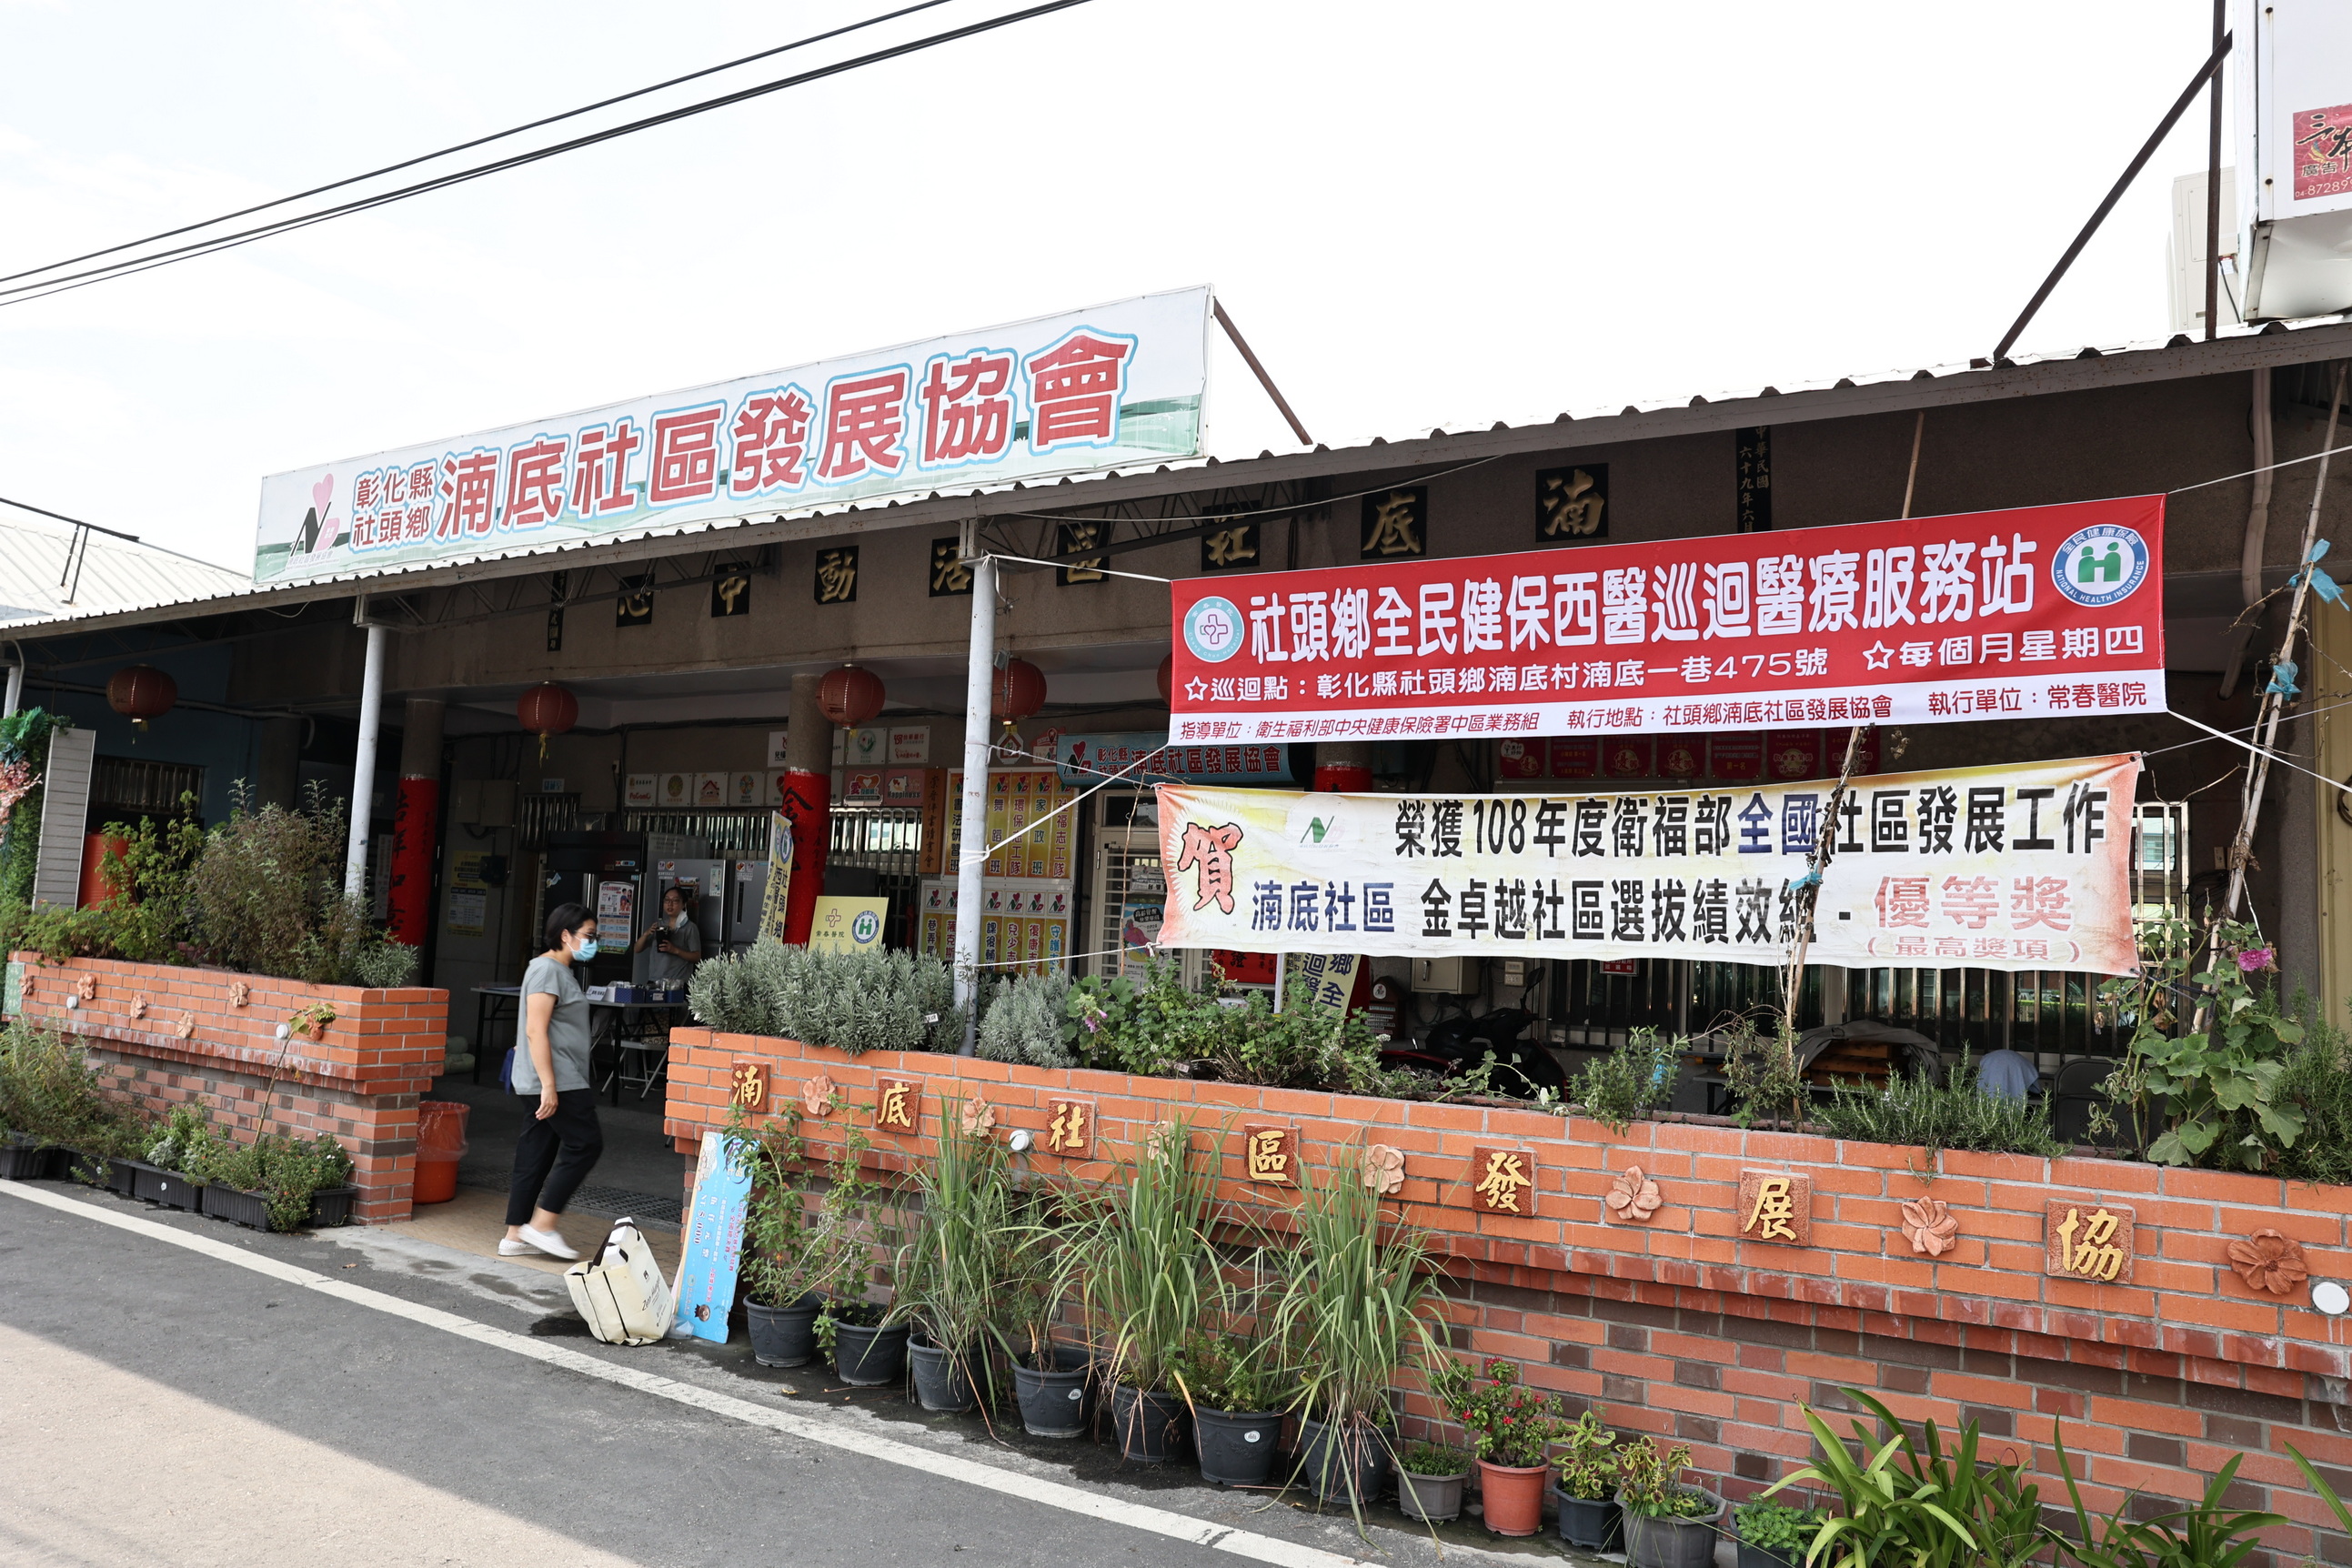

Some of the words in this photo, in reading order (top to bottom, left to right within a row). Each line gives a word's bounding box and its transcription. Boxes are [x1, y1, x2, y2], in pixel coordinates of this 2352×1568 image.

[2302, 162, 2337, 176] 廣告
[437, 335, 1129, 539] 湳底社區發展協會
[357, 465, 434, 509] 彰化縣
[353, 505, 431, 548] 社頭鄉
[2062, 527, 2140, 555] 全民健康保險
[1250, 532, 2037, 664] 社頭鄉全民健保西醫巡迴醫療服務站
[2055, 569, 2077, 598] NATIONAL
[2079, 594, 2113, 603] HEALTH
[2114, 560, 2145, 598] INSURANCE
[1898, 626, 2145, 667] 每個月星期四
[1180, 711, 1541, 740] 指導單位：衛生福利部中央健康保險署中區業務組
[1568, 695, 1893, 729] 執行地點：社頭鄉湳底社區發展協會
[1928, 681, 2147, 717] 執行單位：常春醫院
[887, 790, 920, 799] Happiness
[1031, 799, 1047, 875] 家政班
[1177, 821, 1244, 916] 賀
[1251, 879, 1395, 933] 湳底社區
[1874, 875, 2072, 932] 優等獎
[946, 920, 957, 966] 薩克斯
